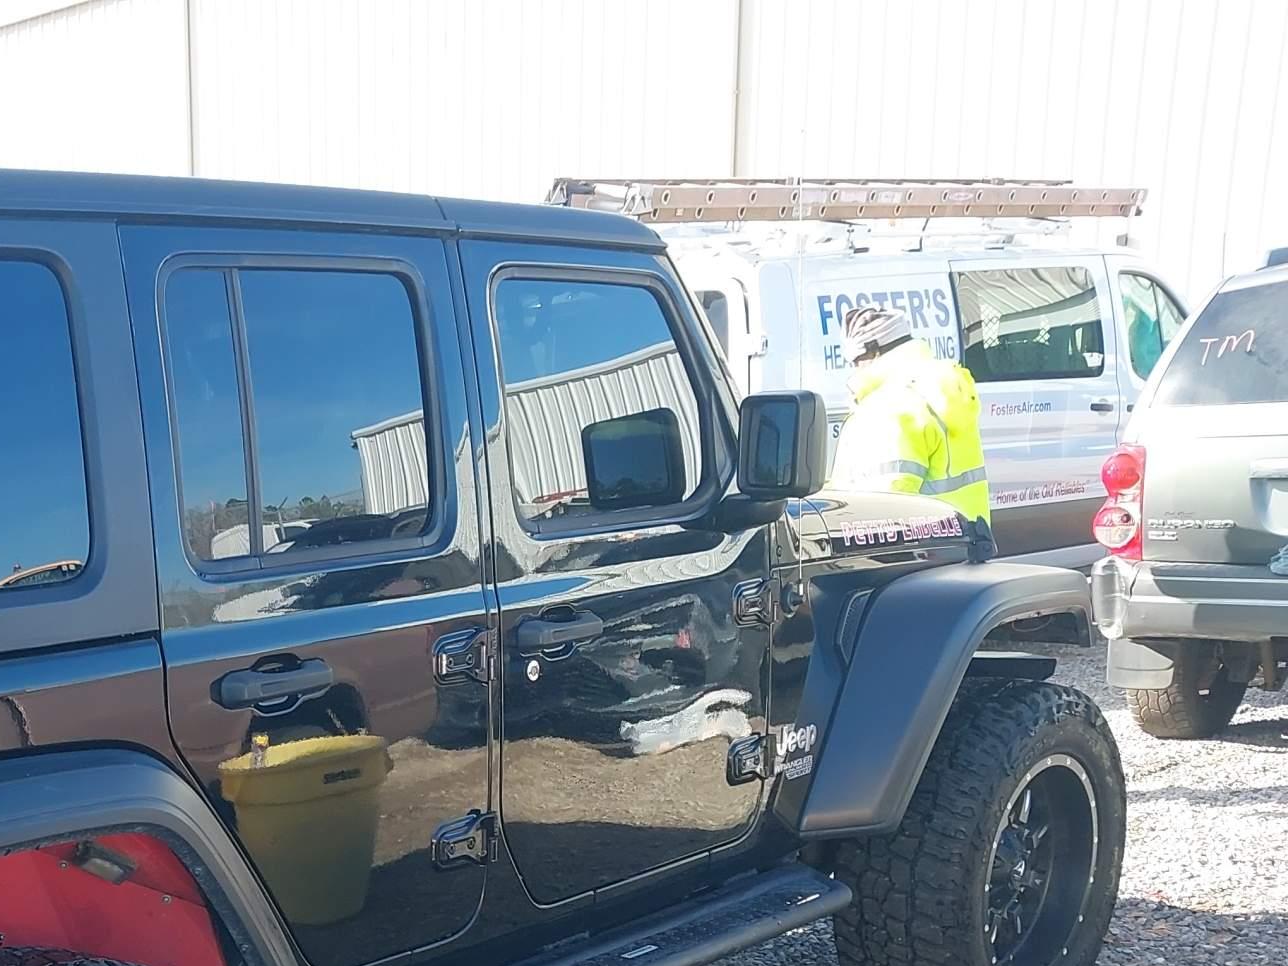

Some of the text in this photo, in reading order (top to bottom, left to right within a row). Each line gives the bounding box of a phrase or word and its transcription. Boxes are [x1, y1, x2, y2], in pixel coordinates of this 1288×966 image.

[1199, 329, 1255, 366] TM
[990, 401, 1052, 417] FostersAir.com
[1019, 487, 1028, 500] of
[776, 724, 817, 756] Jeep
